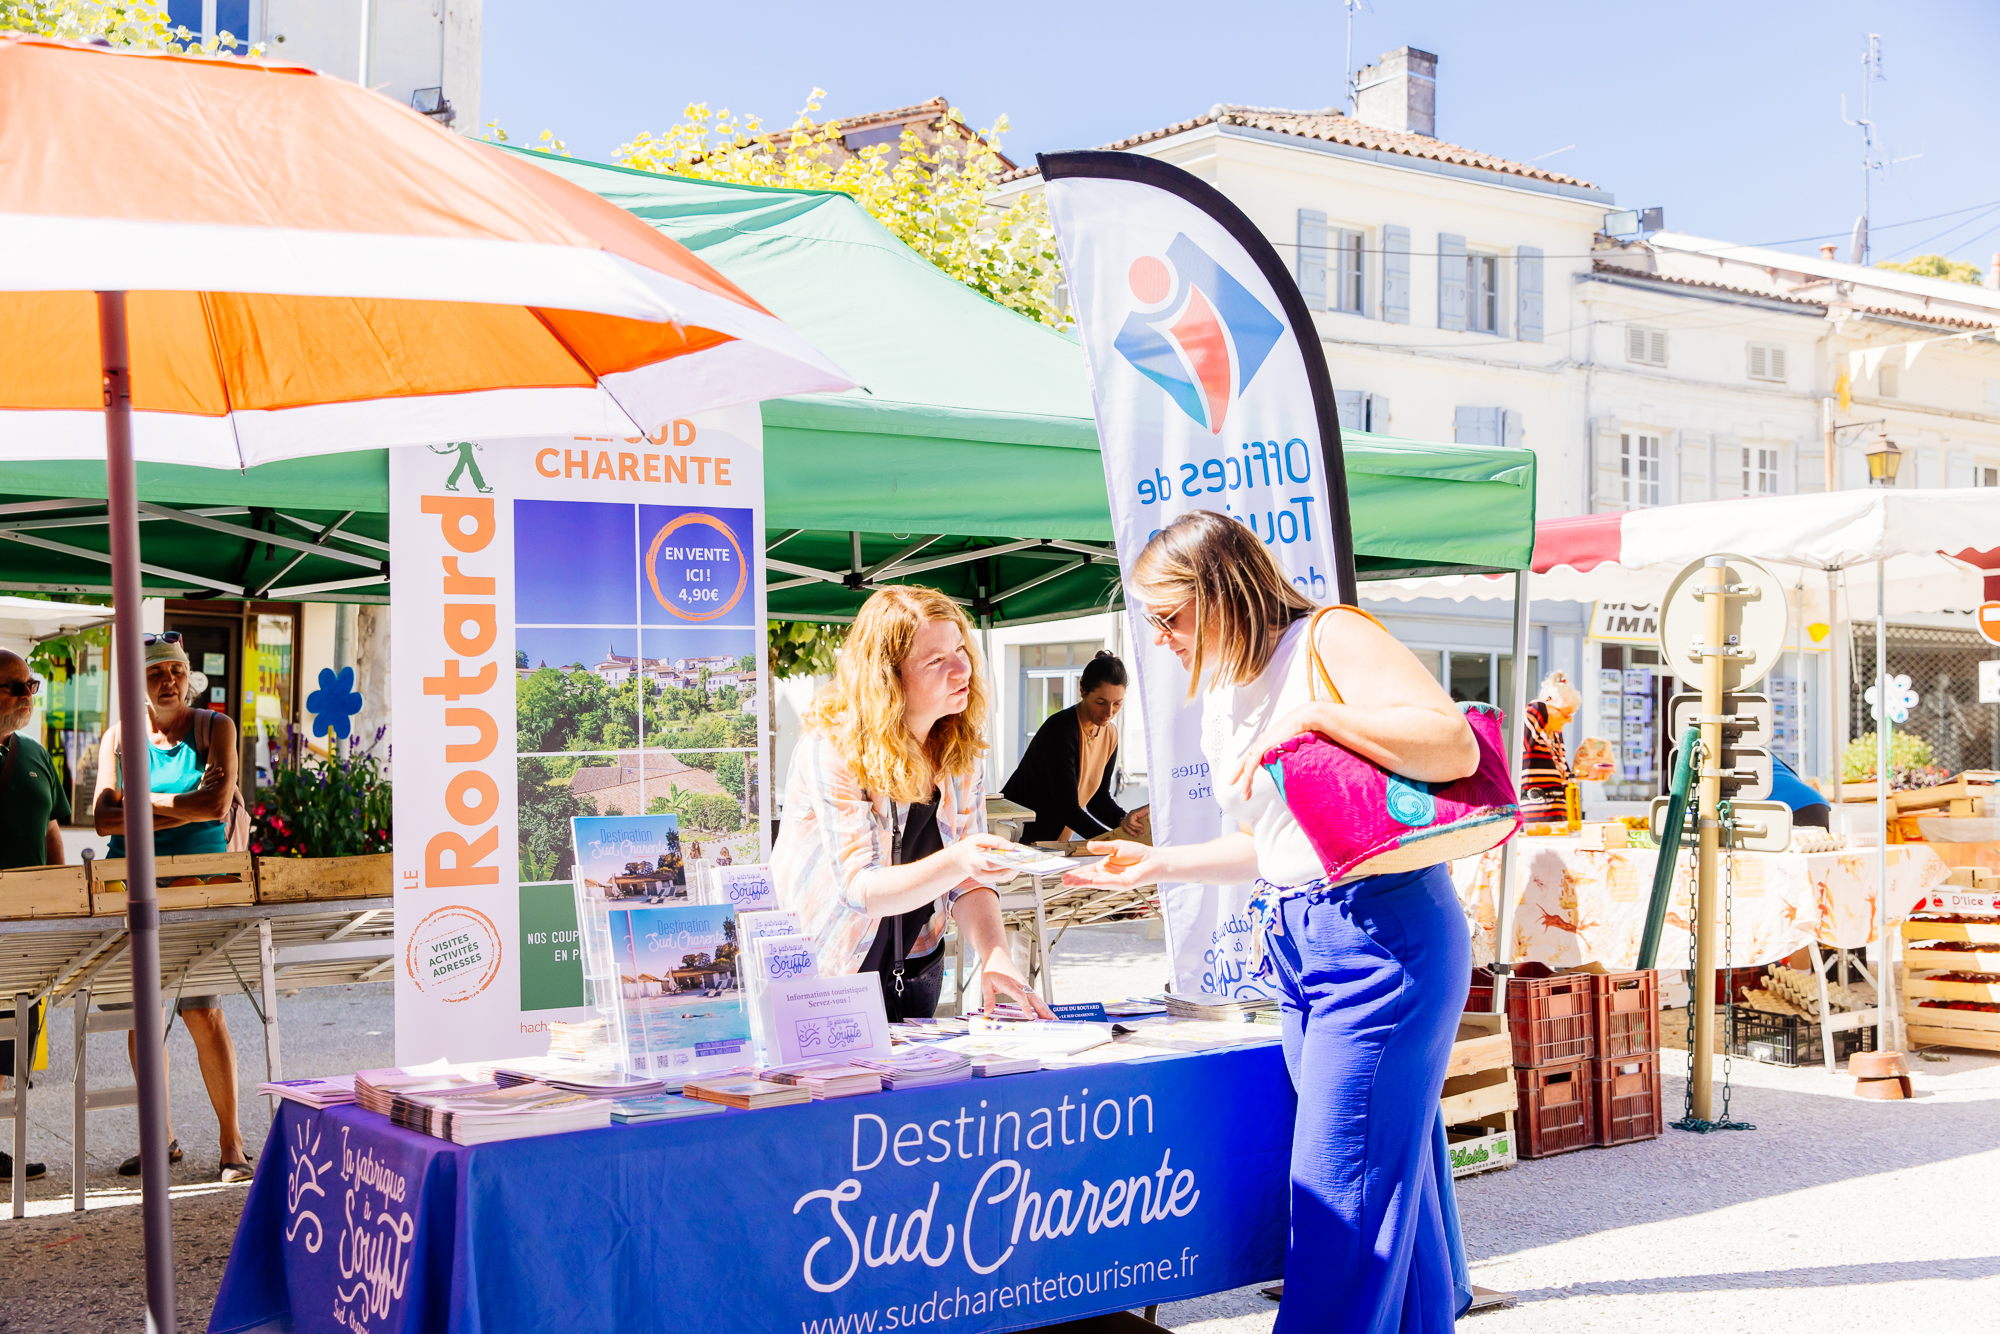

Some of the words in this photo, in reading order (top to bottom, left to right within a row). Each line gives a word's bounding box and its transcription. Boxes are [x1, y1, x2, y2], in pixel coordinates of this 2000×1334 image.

[535, 448, 733, 486] CHARENTE
[665, 547, 683, 561] EN
[685, 547, 730, 562] VENTE
[686, 568, 703, 582] ICI
[678, 588, 719, 604] 4,90€
[420, 494, 499, 888] Routard
[600, 828, 653, 844] Destination
[588, 839, 620, 859] Sud
[403, 869, 418, 890] LE
[730, 878, 770, 901] Souffle
[1952, 895, 1984, 906] D'lice
[657, 918, 710, 936] Destination
[431, 933, 469, 953] VISITES
[527, 932, 547, 945] NOS
[645, 931, 677, 952] Sud
[677, 930, 725, 951] Charente
[429, 941, 479, 967] ACTIVITÉS
[554, 949, 568, 962] EN
[572, 949, 583, 960] P
[778, 944, 803, 955] fabrique
[432, 953, 482, 977] ADRESSES
[771, 950, 811, 974] Souffle
[786, 989, 830, 1002] Informations
[831, 985, 868, 997] touristiques
[808, 997, 847, 1008] Servez-vous
[827, 1022, 862, 1045] Souffle
[852, 1088, 1153, 1172] Destination
[340, 1126, 354, 1181] La
[355, 1147, 406, 1210] fabrique
[364, 1193, 371, 1221] à
[793, 1178, 955, 1293] Sud
[962, 1148, 1200, 1275] Charente
[339, 1188, 414, 1320] Souffl
[801, 1246, 1200, 1334] www.sudcharentetourisme.fr
